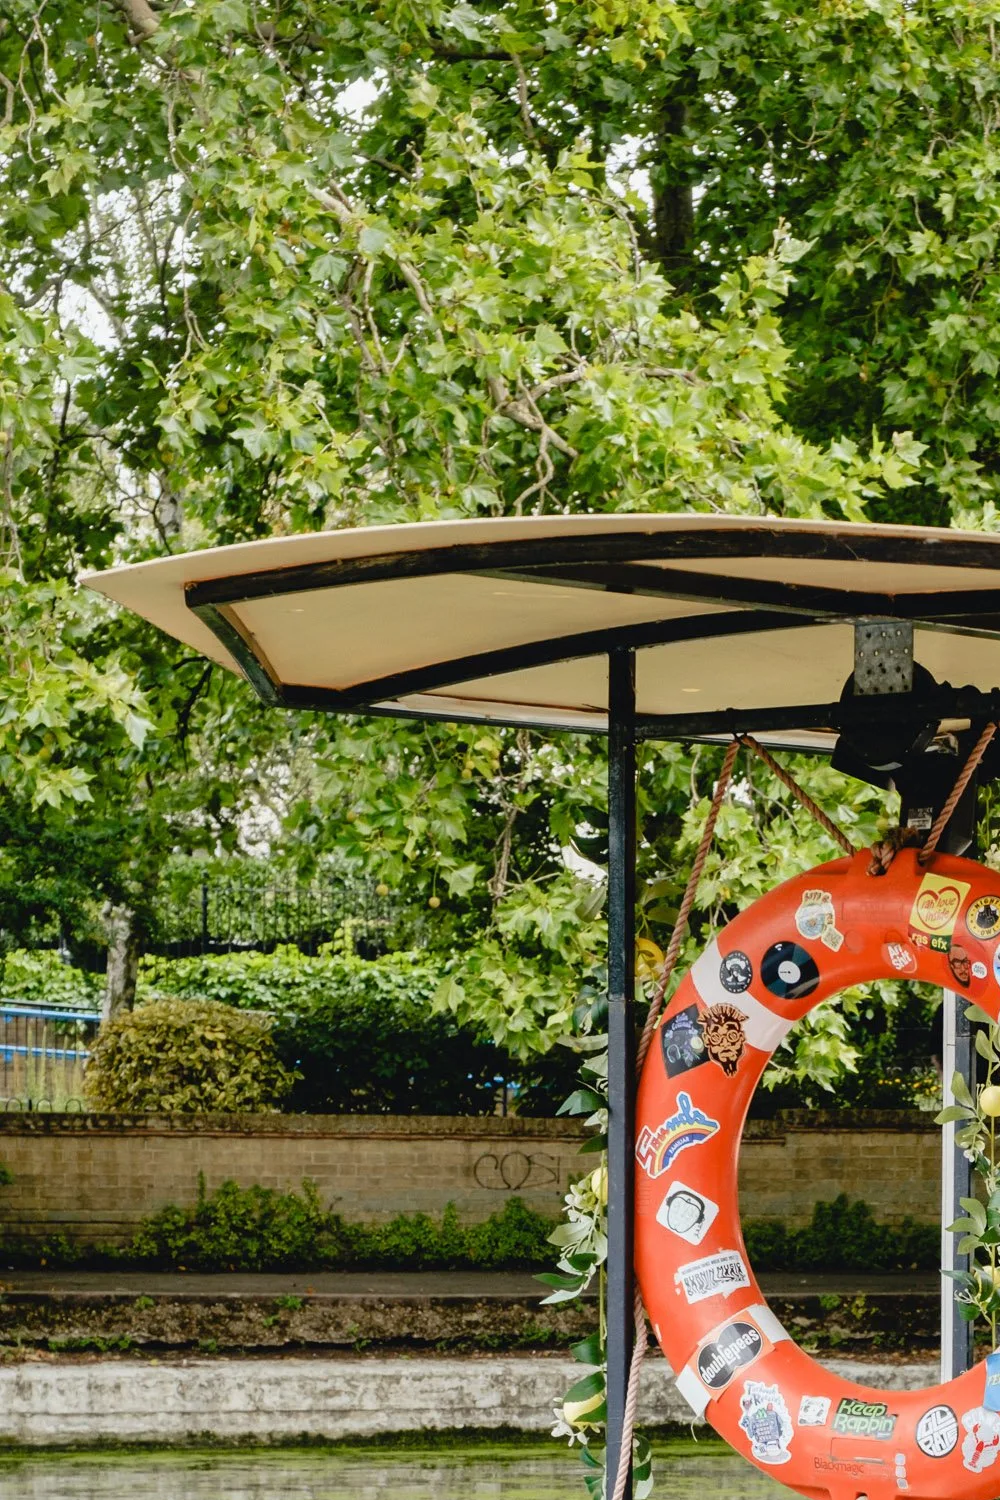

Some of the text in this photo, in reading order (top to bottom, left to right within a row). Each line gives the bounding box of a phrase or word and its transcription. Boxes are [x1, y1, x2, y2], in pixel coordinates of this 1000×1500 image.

[912, 933, 948, 951] ras efx
[716, 1262, 743, 1279] MUSIC
[838, 1399, 887, 1417] Keep
[814, 1457, 865, 1476] Blackmagic
